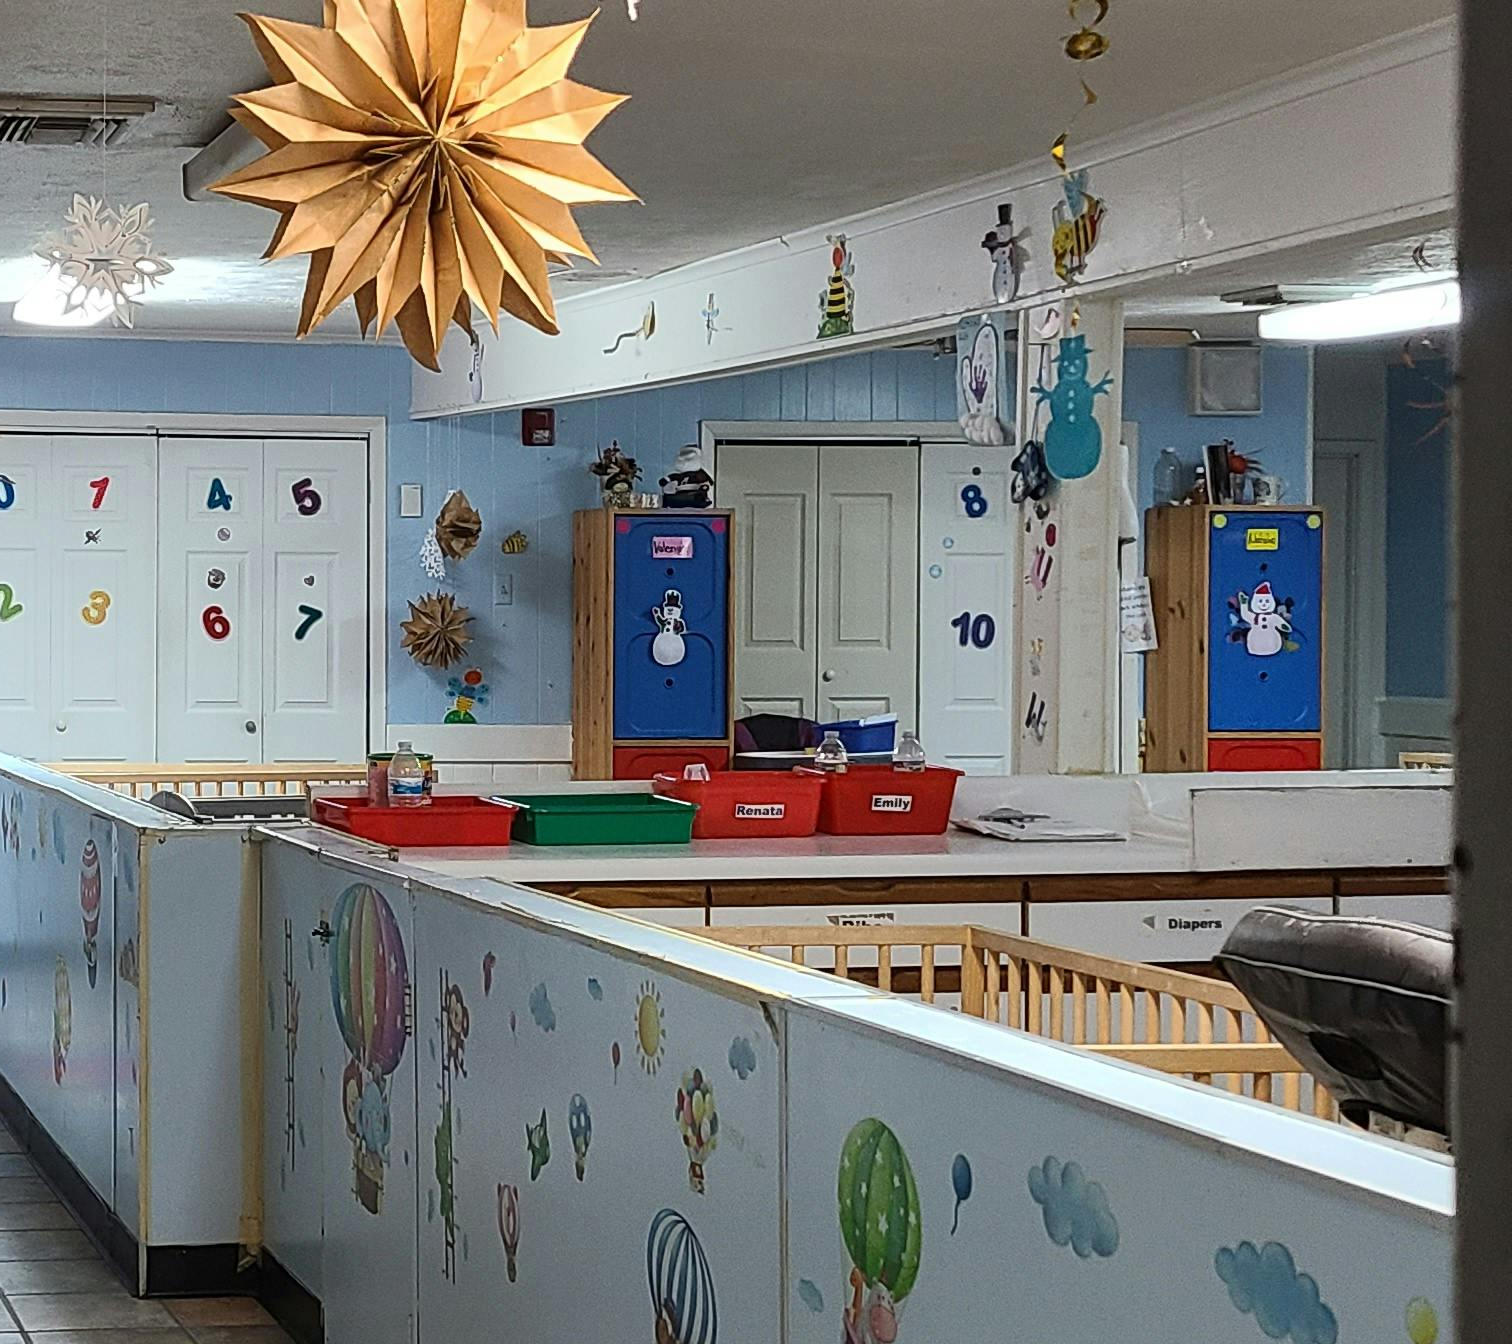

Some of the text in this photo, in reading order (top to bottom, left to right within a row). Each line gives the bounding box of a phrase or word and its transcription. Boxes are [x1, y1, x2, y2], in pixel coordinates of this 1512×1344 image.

[89, 477, 110, 509] 1
[206, 478, 232, 510] 4
[292, 478, 322, 515] 5
[961, 484, 988, 518] 8
[82, 591, 111, 625] 3
[202, 606, 230, 639] 6
[295, 605, 322, 640] 7
[951, 612, 995, 648] 10
[737, 806, 783, 816] Renata
[873, 797, 910, 810] Emily
[1168, 918, 1223, 932] Diapers
